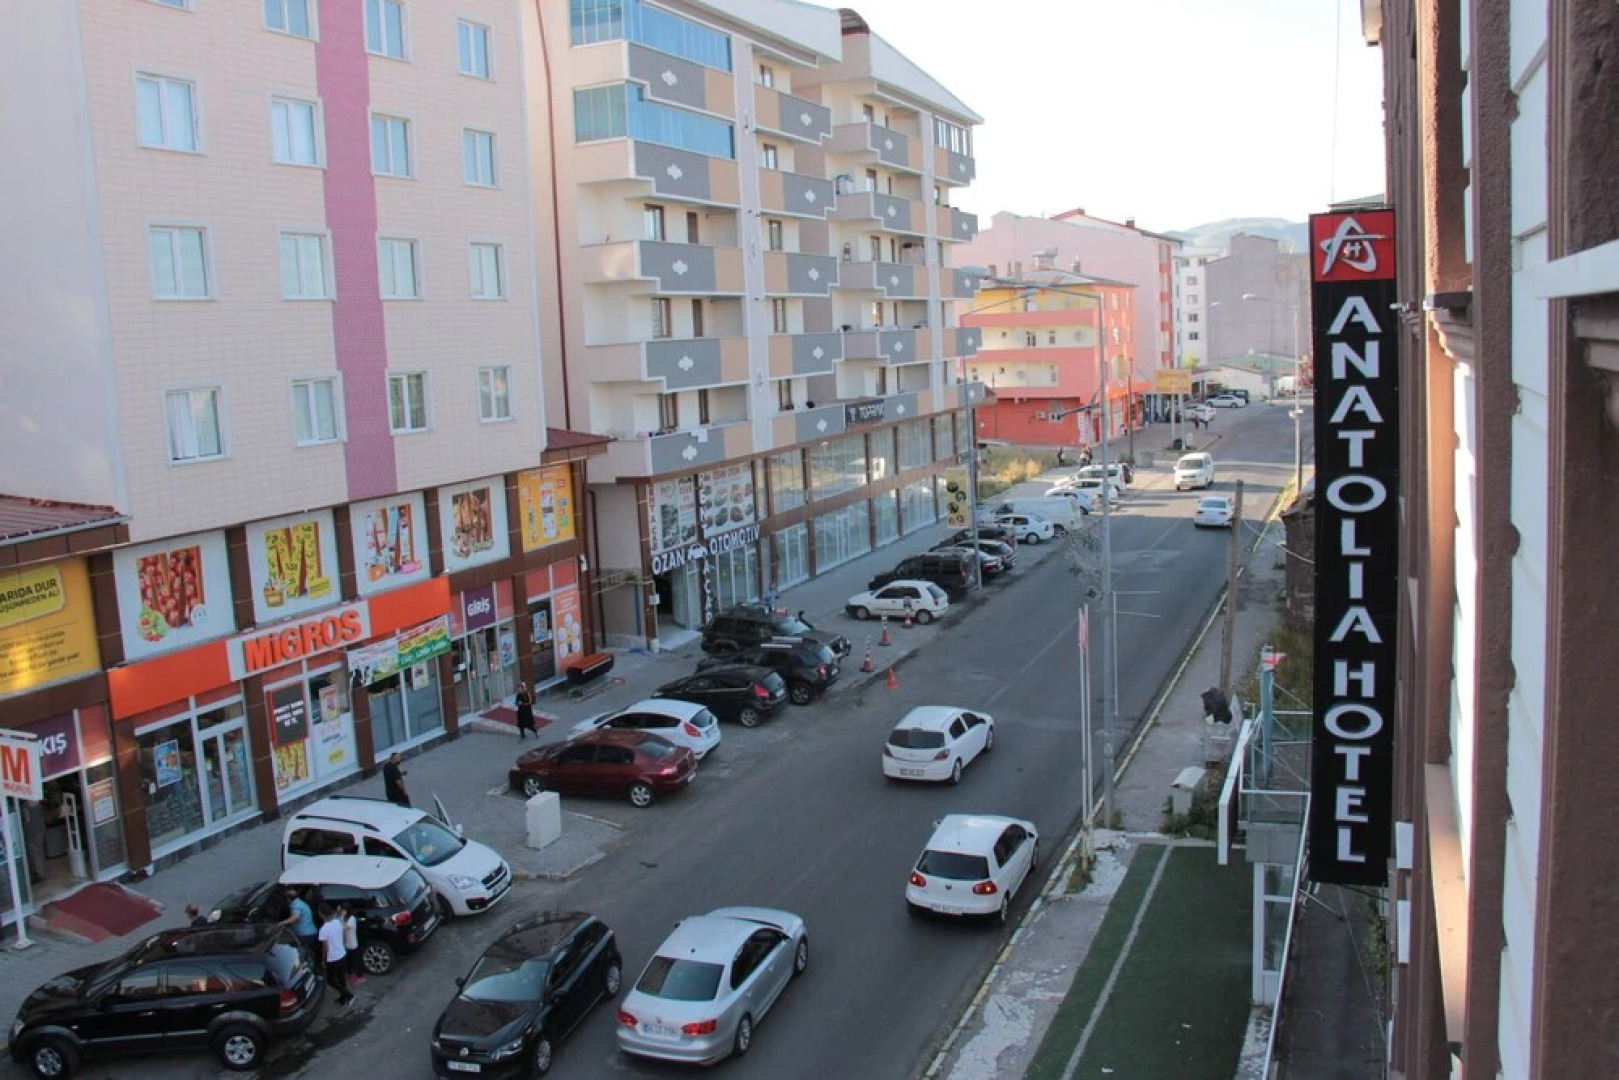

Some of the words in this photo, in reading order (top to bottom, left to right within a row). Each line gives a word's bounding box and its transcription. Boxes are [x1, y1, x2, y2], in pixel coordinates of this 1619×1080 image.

[1326, 295, 1386, 644] ANATOLIA
[34, 578, 57, 593] DUR
[652, 548, 685, 576] OZAN
[1322, 660, 1383, 863] HOTEL
